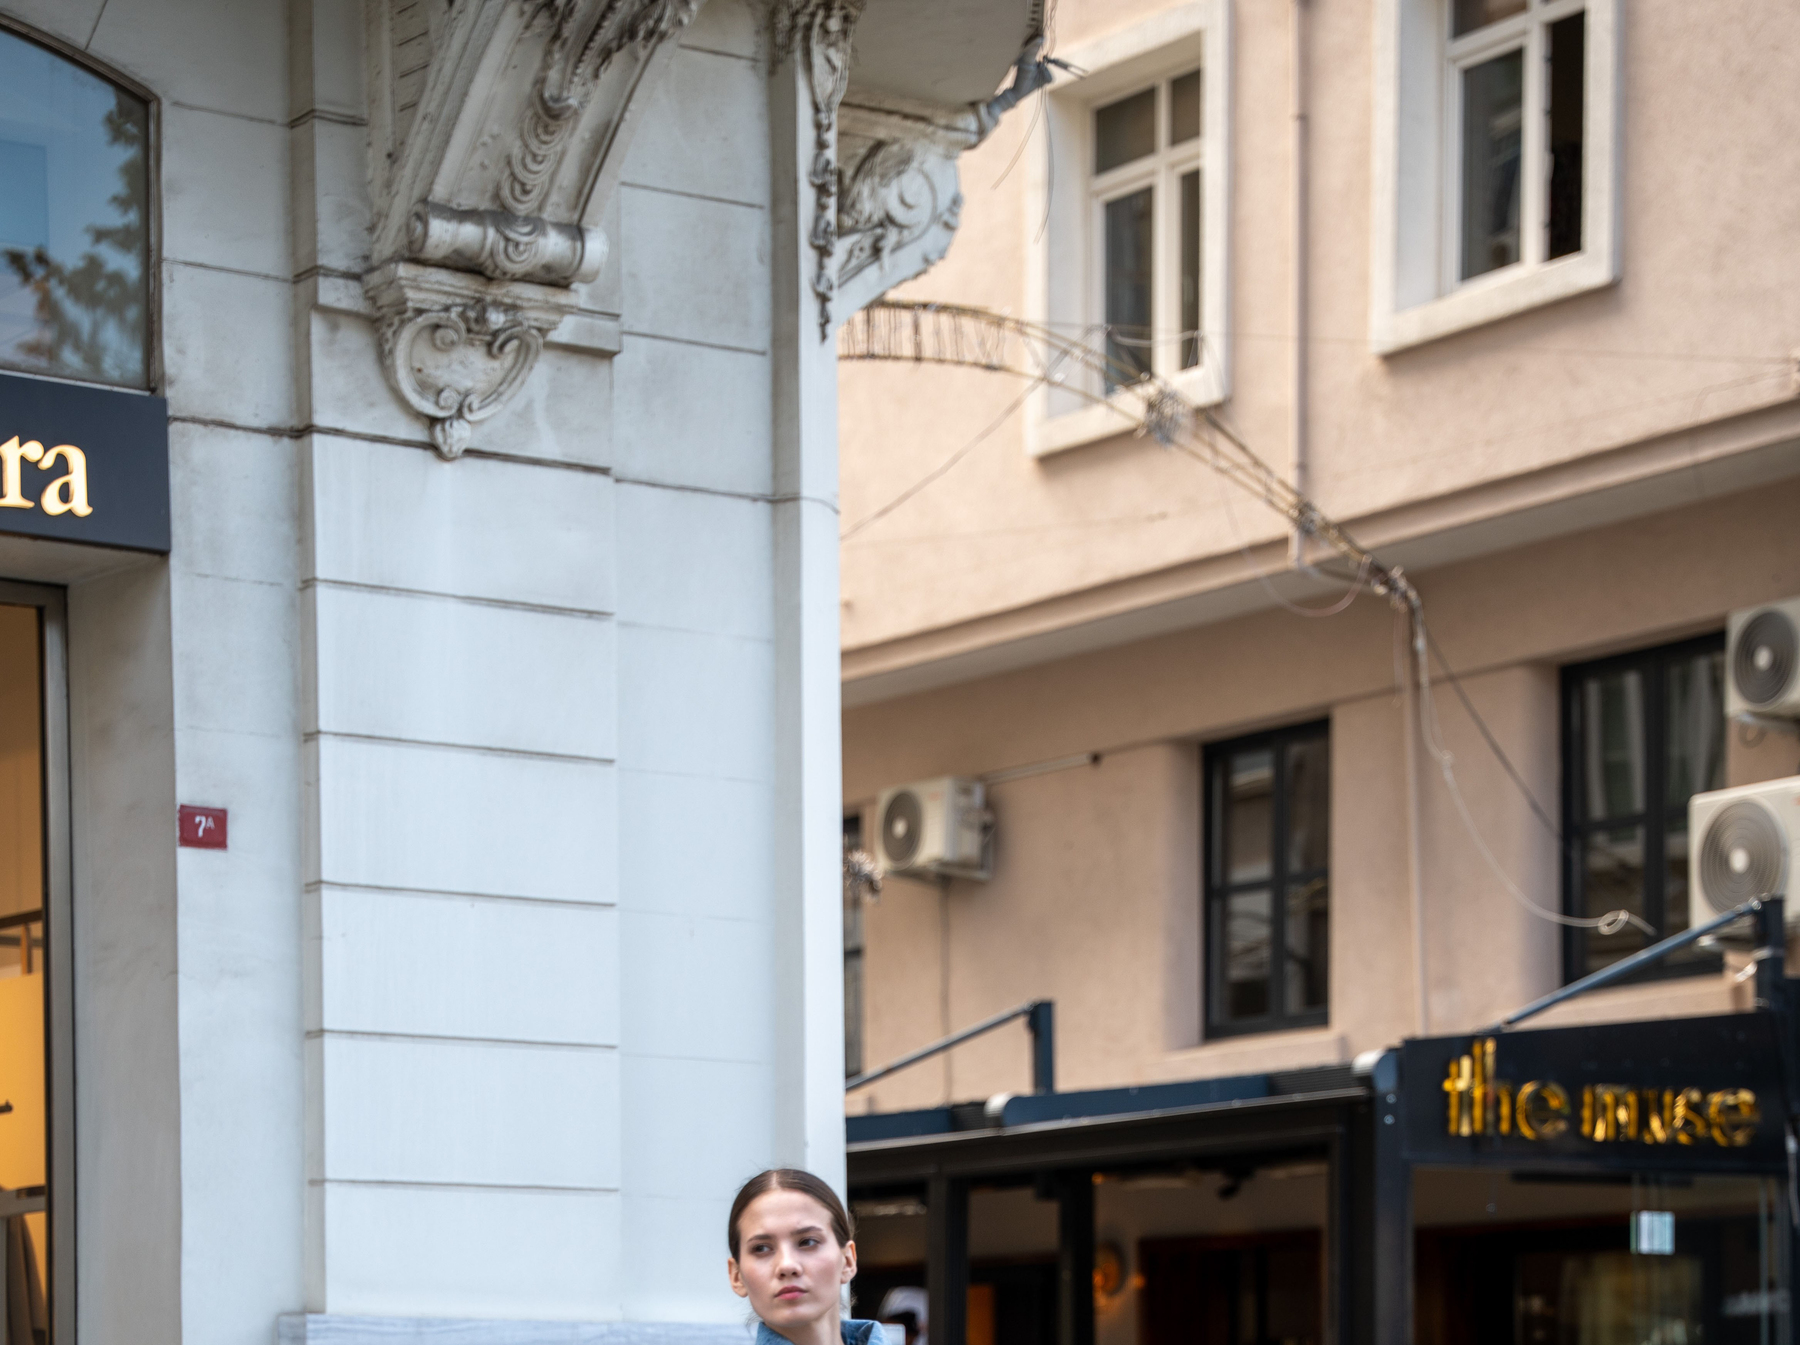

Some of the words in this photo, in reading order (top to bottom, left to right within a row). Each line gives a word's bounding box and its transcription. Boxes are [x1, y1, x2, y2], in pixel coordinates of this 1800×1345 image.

[0, 435, 93, 518] ra
[1442, 1037, 1571, 1141] the
[1580, 1083, 1759, 1148] muse
